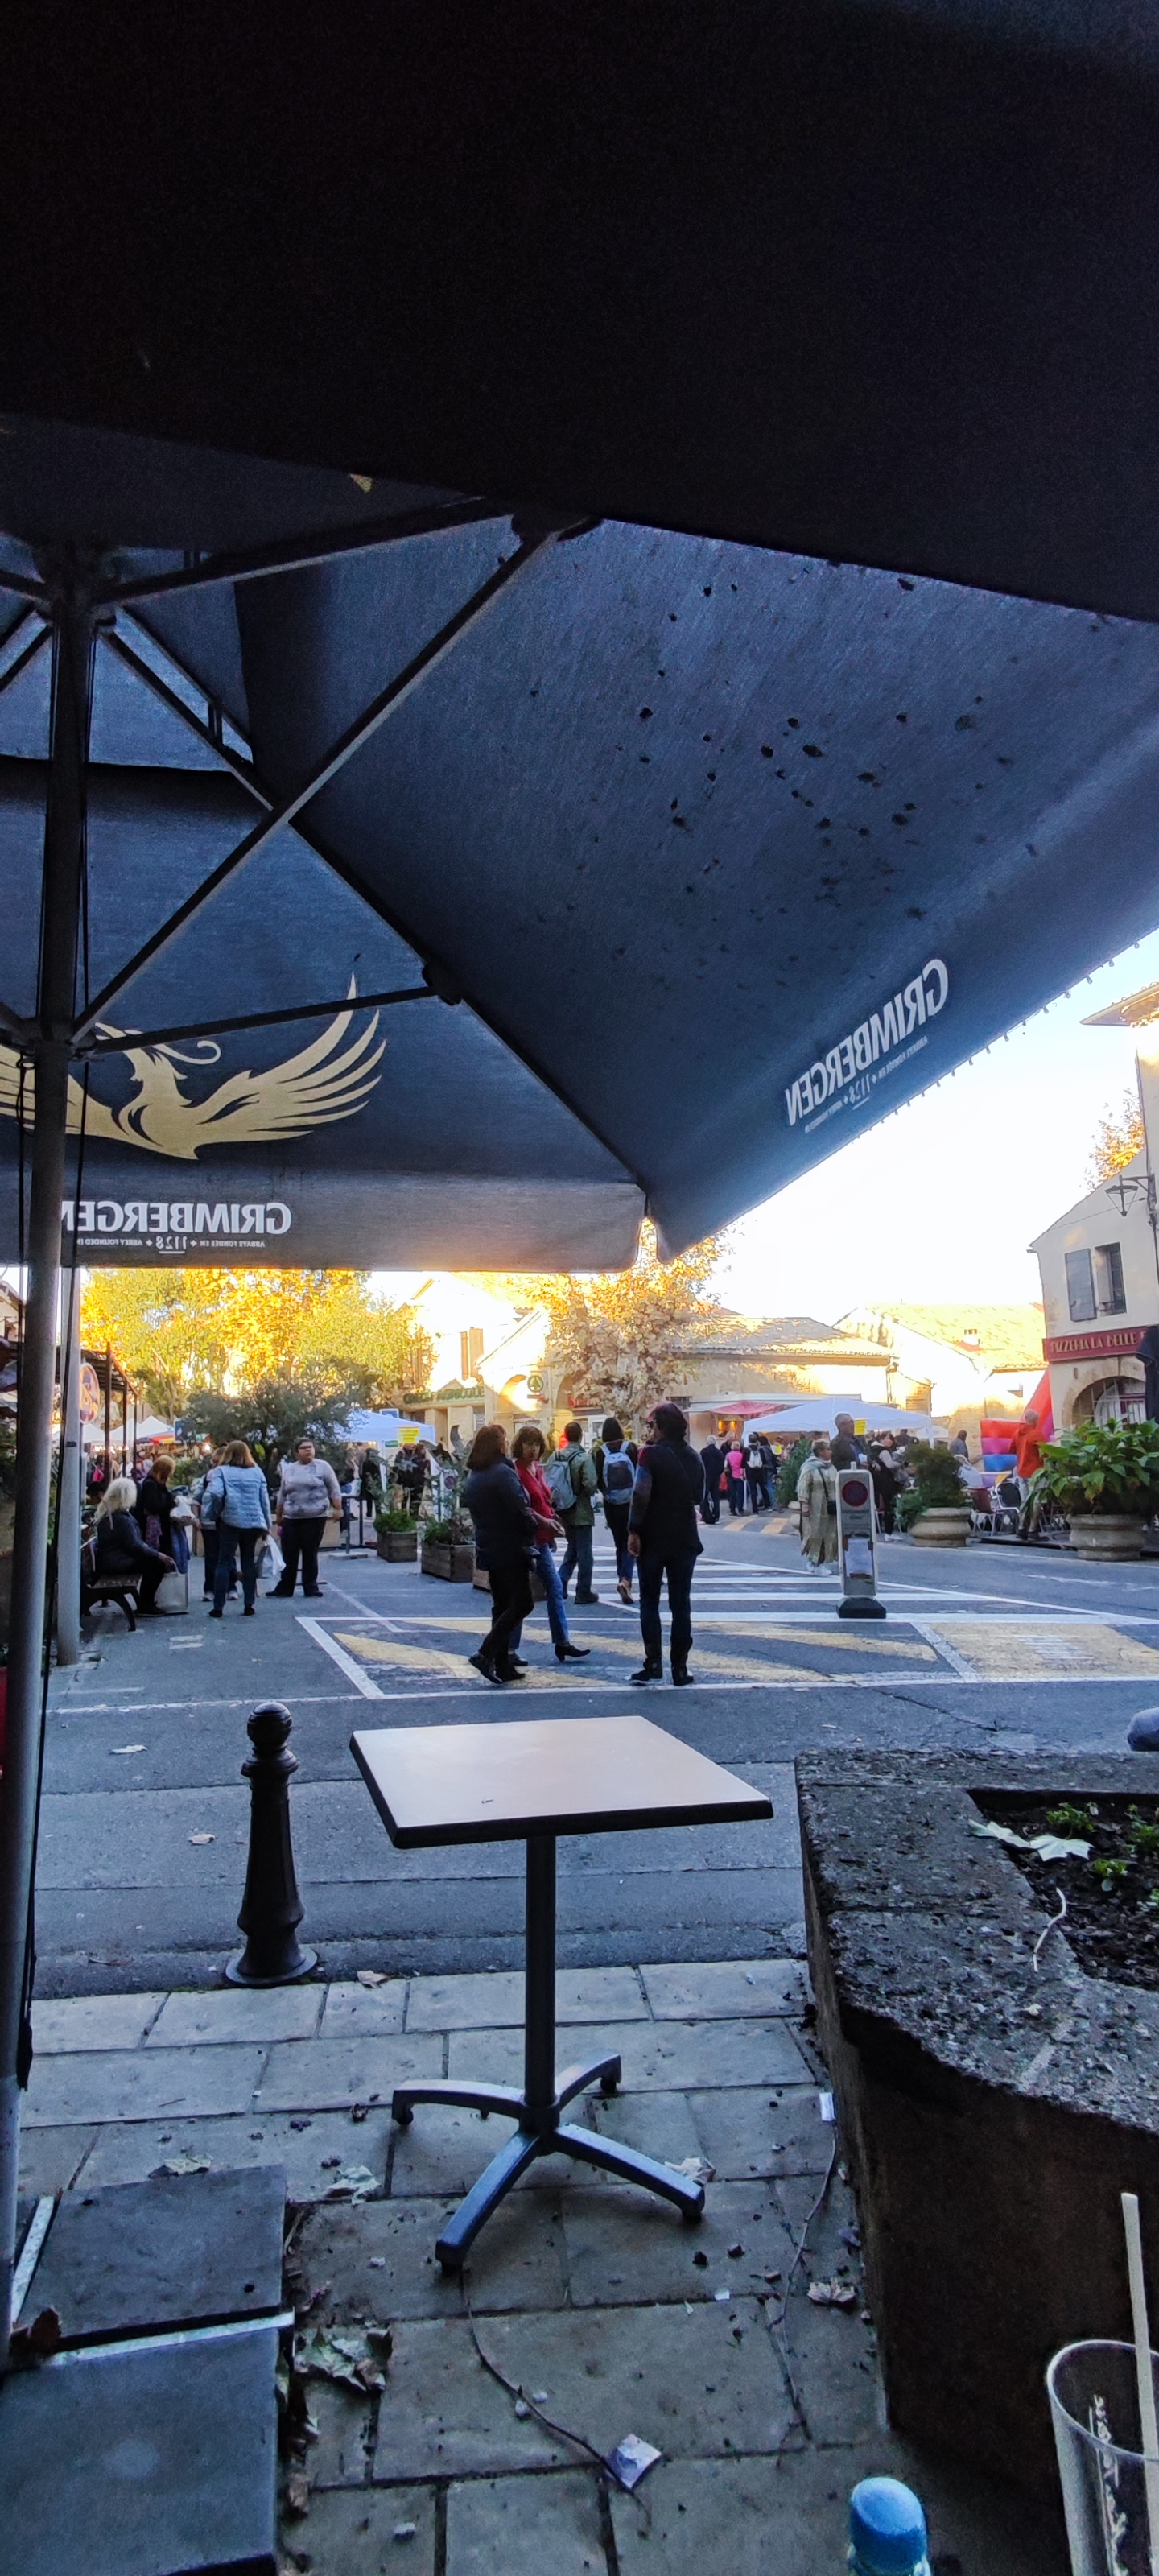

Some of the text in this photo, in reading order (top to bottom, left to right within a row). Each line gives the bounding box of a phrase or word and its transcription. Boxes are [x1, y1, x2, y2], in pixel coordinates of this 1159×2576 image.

[1050, 1338, 1089, 1353] PIZZERIA
[1091, 1336, 1103, 1348] LA
[1107, 1332, 1136, 1348] BELLE
